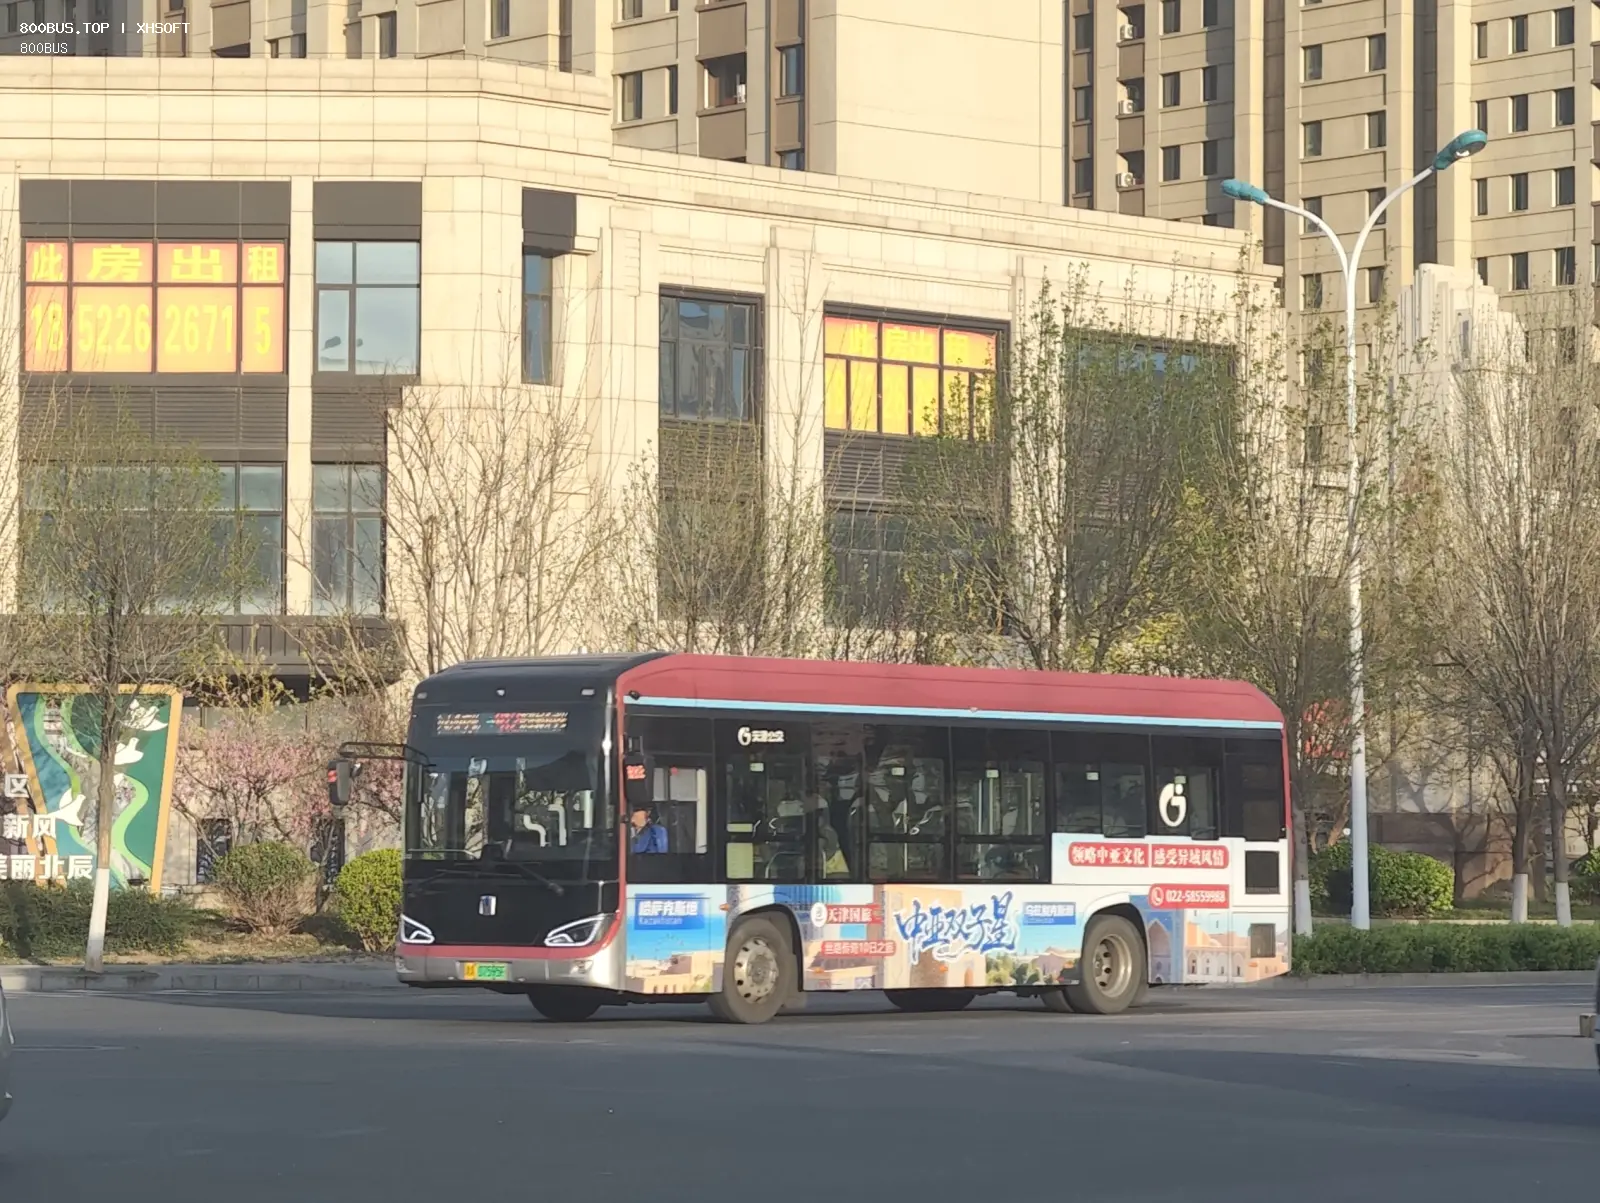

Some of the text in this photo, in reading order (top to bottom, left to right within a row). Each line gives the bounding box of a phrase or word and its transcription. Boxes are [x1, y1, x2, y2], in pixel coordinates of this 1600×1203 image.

[31, 243, 279, 282] 此房出租
[4, 774, 30, 799] 区
[3, 813, 57, 840] 新风
[1071, 845, 1146, 866] 领略中亚文化
[1153, 847, 1225, 867] 感受异域风情
[893, 888, 1017, 960] 中亚双子星
